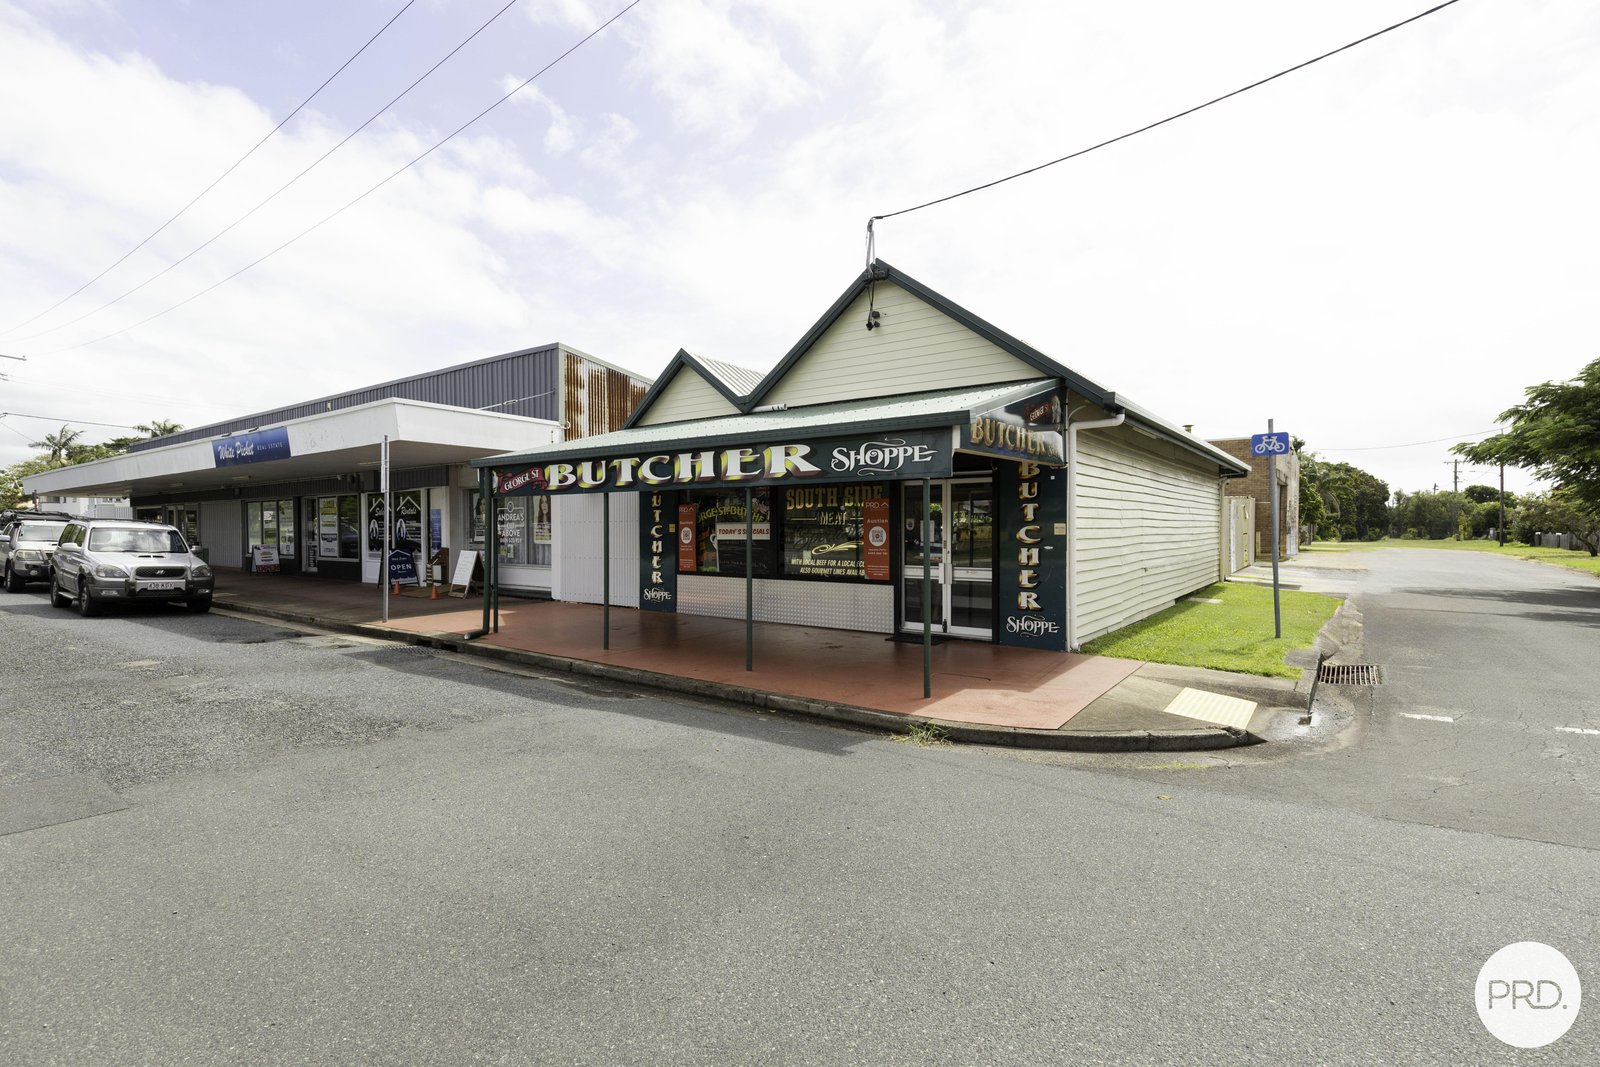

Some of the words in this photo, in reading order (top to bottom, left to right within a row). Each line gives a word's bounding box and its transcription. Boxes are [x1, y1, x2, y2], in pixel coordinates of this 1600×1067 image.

[970, 416, 1047, 455] BUTCHER
[217, 443, 235, 459] White
[544, 444, 822, 490] BUTCHER
[830, 438, 938, 475] SHOPPE
[504, 473, 530, 491] GEORGE
[530, 469, 539, 480] ST
[786, 487, 838, 510] SOUTH
[844, 485, 883, 507] SIDE
[497, 512, 525, 521] ANDREA'S
[501, 529, 520, 537] ABOVE
[651, 489, 663, 584] UTCHER
[1017, 461, 1041, 612] BUTCHER
[643, 587, 672, 603] SHOPPE
[1006, 614, 1060, 637] SHOPPE
